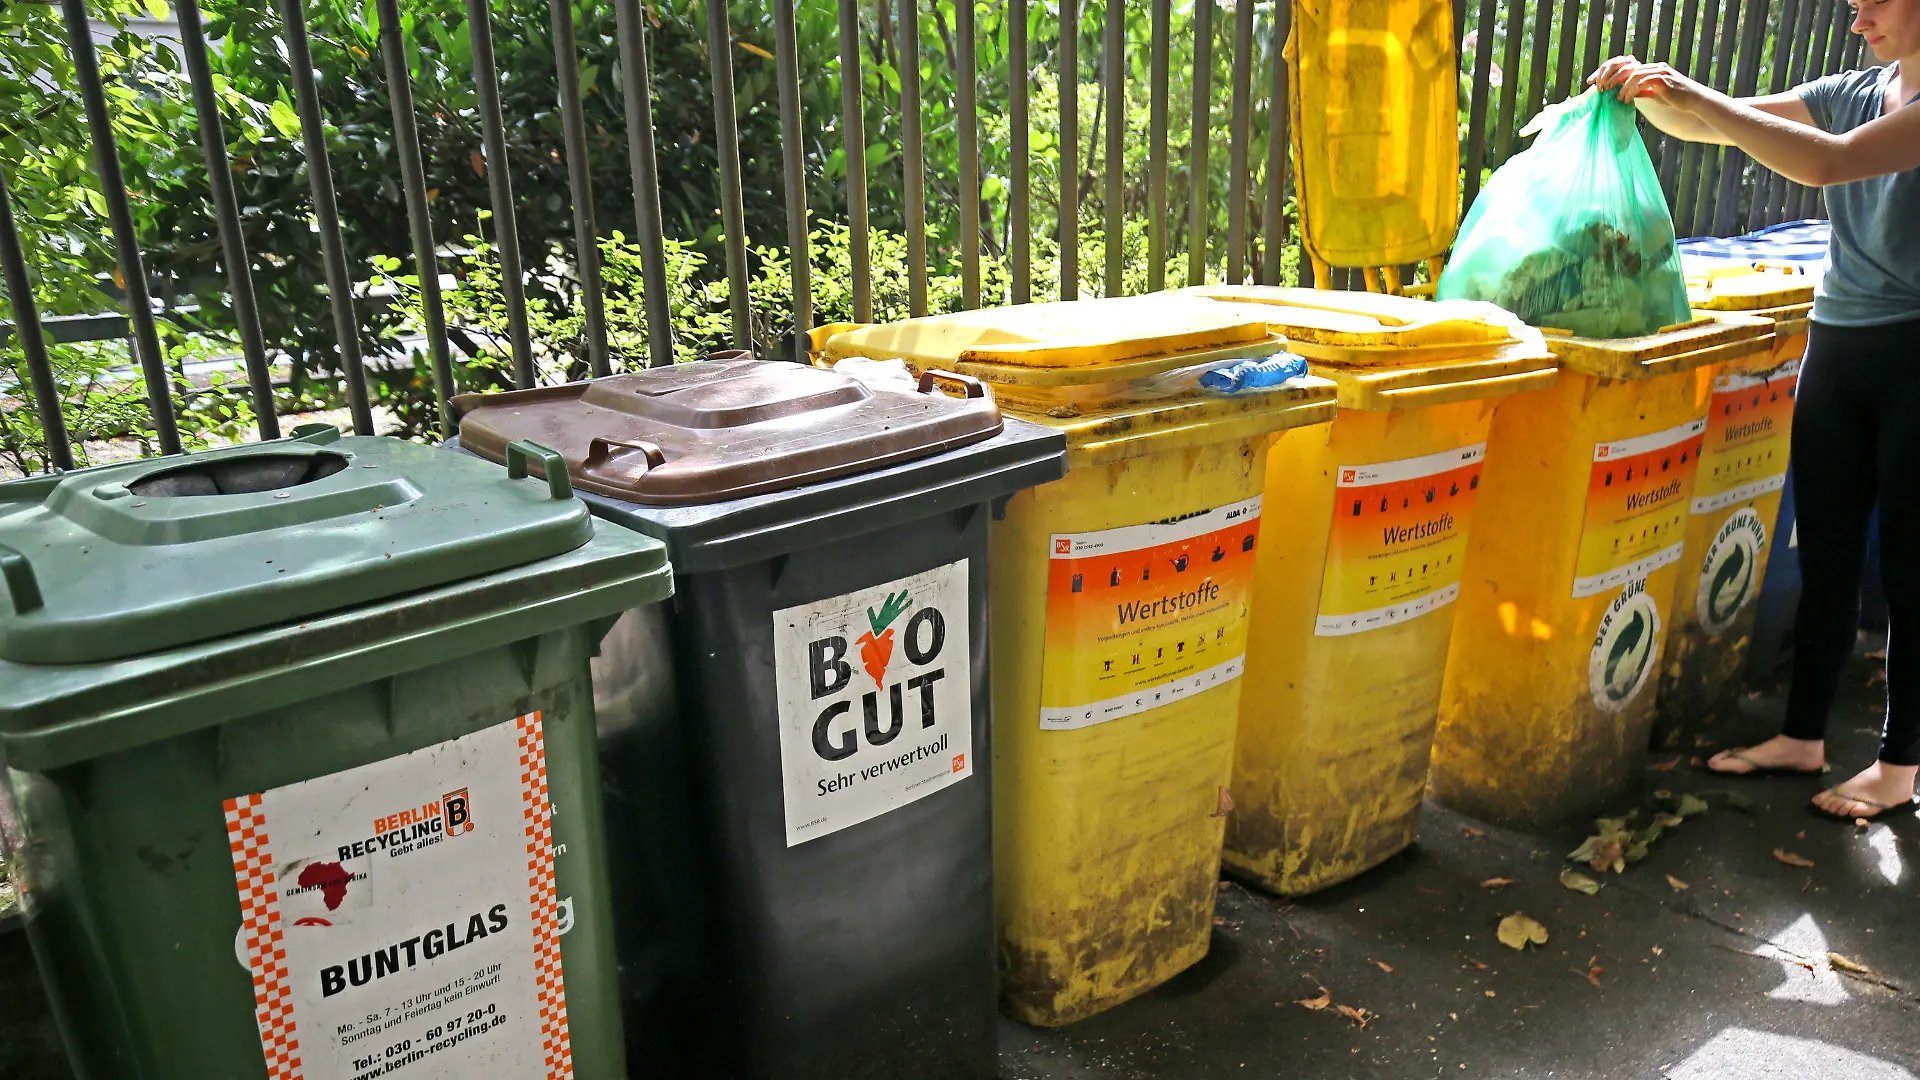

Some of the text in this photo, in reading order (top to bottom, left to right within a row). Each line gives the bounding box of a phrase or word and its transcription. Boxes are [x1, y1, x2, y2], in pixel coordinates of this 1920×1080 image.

[1725, 416, 1773, 442] Wertstoffe
[1226, 510, 1240, 520] ALBA
[1627, 478, 1682, 511] Wertstoffe
[1056, 541, 1070, 552] BSR
[1383, 512, 1454, 545] Wertstoffe
[1117, 580, 1219, 625] Wertstoffe
[1594, 614, 1612, 647] DER
[1614, 577, 1646, 613] GRÜNE
[811, 668, 945, 762] GUT
[817, 733, 949, 797] Sehr verwertvoll
[337, 817, 442, 862] RECYCLING
[373, 800, 441, 835] BERLIN
[390, 833, 443, 858] Gebt alles!
[320, 904, 508, 998] BUNTGLAS
[337, 1024, 356, 1035] Mo.
[366, 1013, 382, 1024] Sa.
[384, 1007, 391, 1017] 7
[401, 999, 413, 1010] 13
[415, 992, 432, 1005] Uhr
[434, 983, 451, 997] und
[454, 977, 465, 988] 15
[473, 969, 485, 981] 20
[487, 962, 502, 975] Uhr
[341, 974, 501, 1046] Sonntag und Feiertag kein Einwurf!
[350, 1013, 507, 1080] ww.berlin-recycling.de
[352, 1053, 382, 1071] Tel.:
[386, 1039, 411, 1058] 030
[426, 1026, 443, 1041] 60
[446, 1017, 462, 1033] 97
[466, 1003, 496, 1024] 20-0
